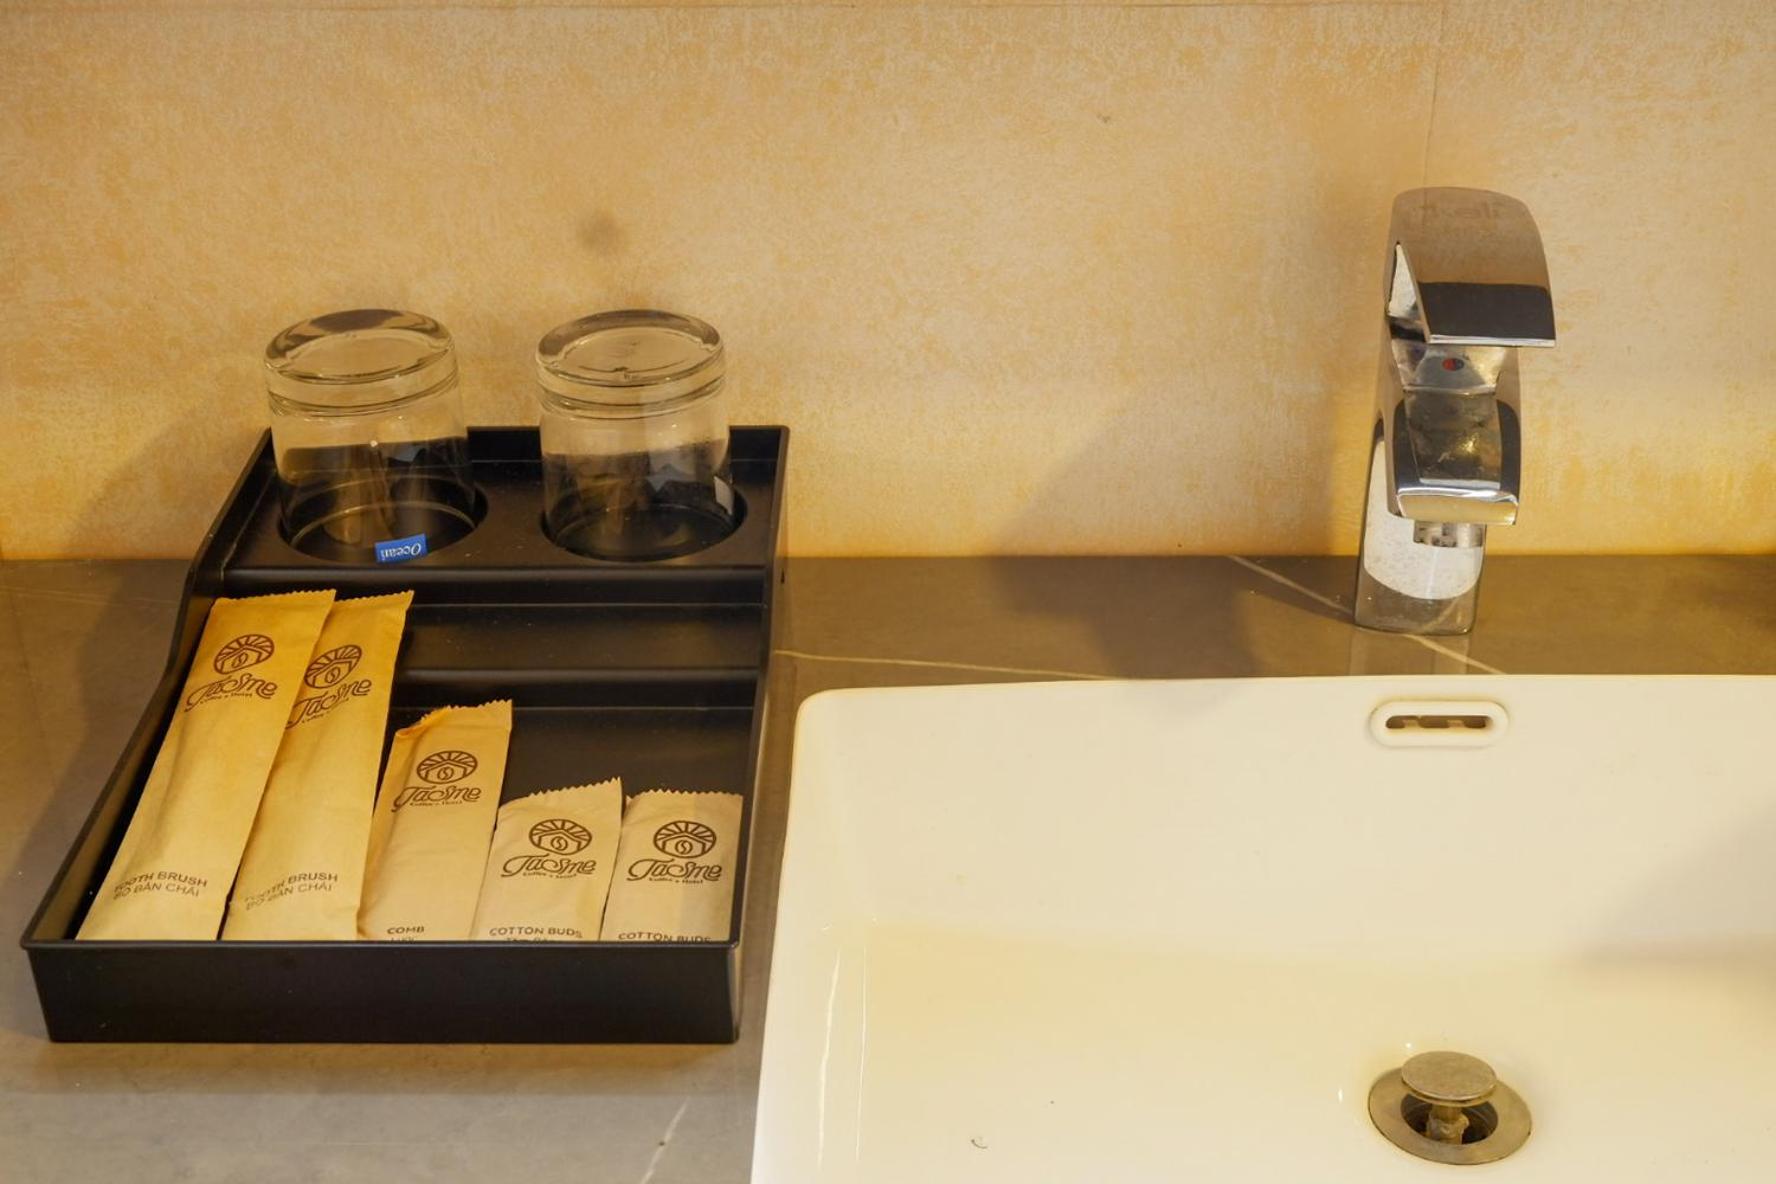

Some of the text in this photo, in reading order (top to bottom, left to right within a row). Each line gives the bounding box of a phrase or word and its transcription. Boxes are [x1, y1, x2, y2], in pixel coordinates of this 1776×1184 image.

[380, 542, 422, 561] Ocean
[157, 870, 208, 888] BRUSH
[287, 872, 338, 885] BRUSH
[387, 925, 425, 935] COMB
[489, 926, 583, 939] COTTON BUDS
[618, 931, 673, 942] COTTON
